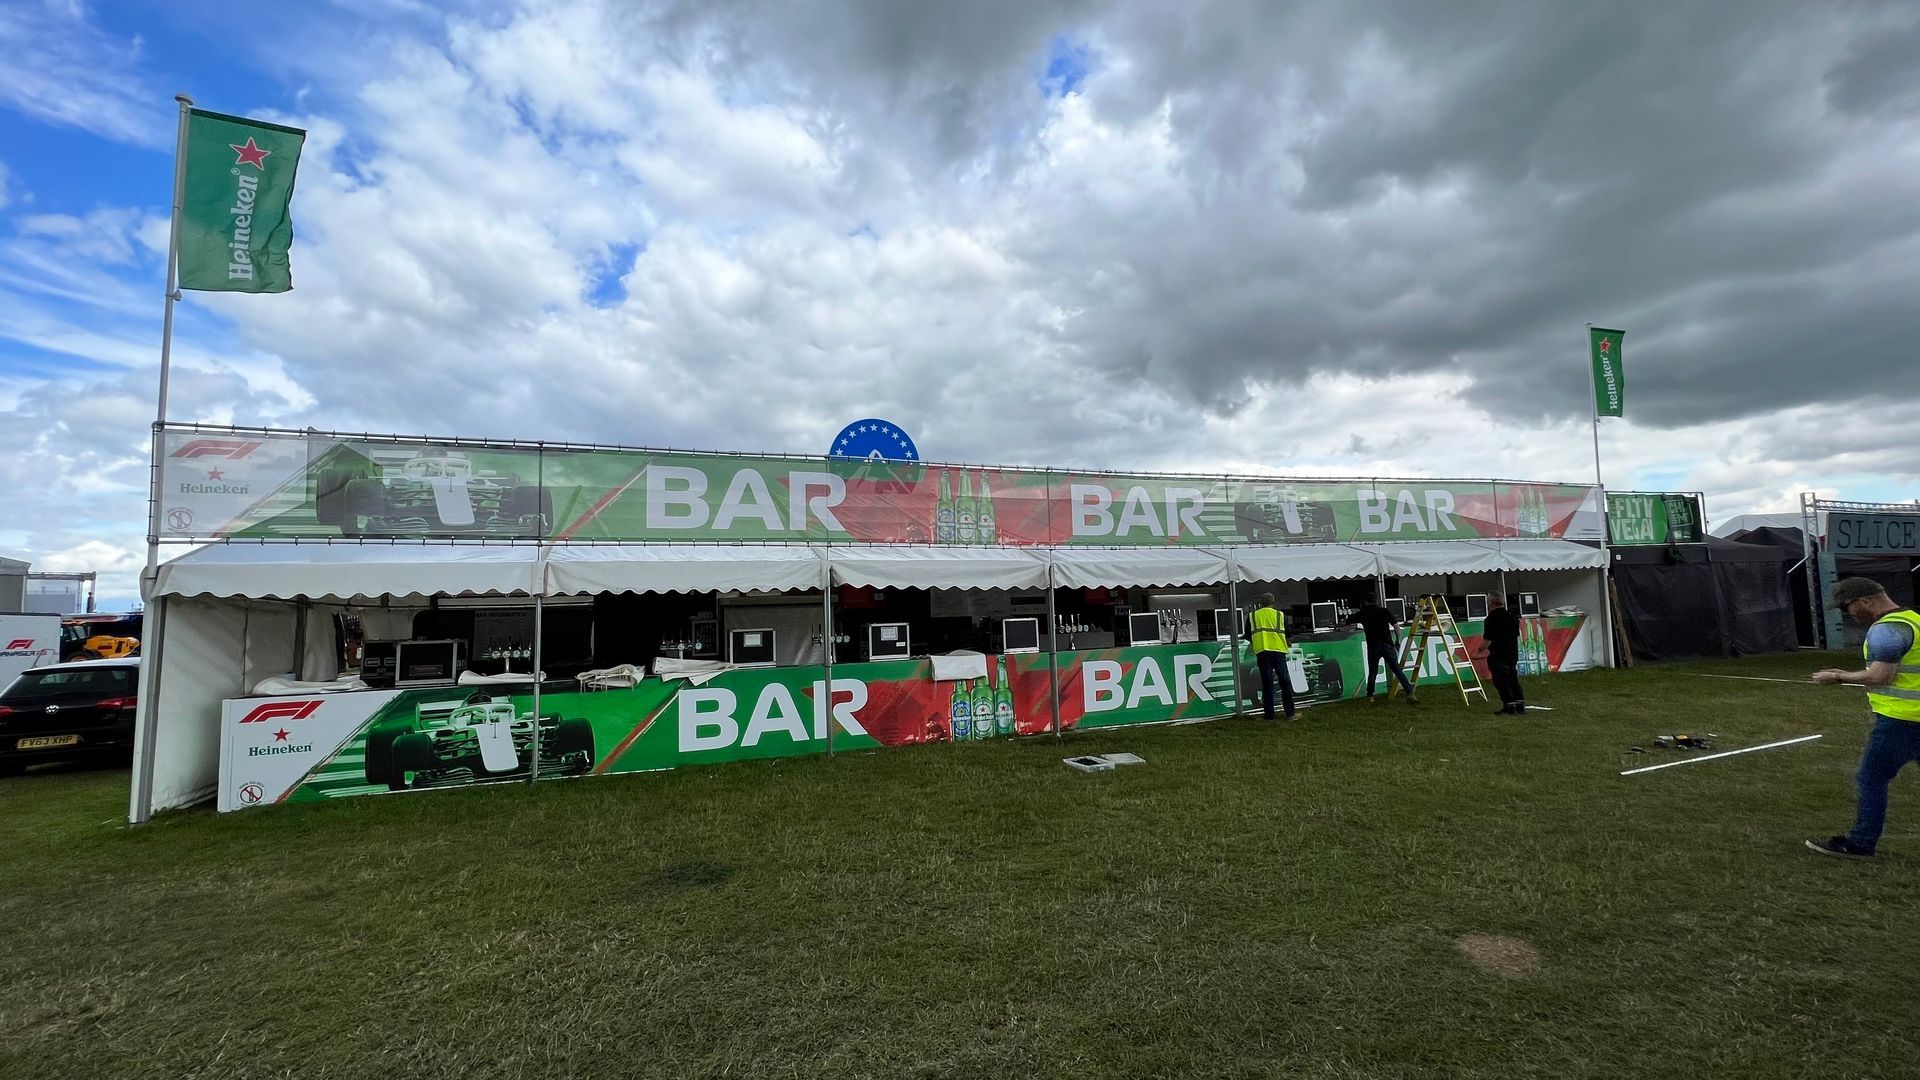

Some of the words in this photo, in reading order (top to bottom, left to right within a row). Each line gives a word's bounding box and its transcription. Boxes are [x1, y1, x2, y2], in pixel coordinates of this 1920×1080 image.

[229, 175, 259, 280] Heineken
[1602, 357, 1618, 409] Heineken
[168, 440, 263, 460] F1
[180, 483, 249, 495] Heineken
[646, 465, 847, 532] BAR
[1071, 484, 1206, 536] BAR
[1358, 489, 1457, 533] BAR
[1838, 519, 1916, 549] SLICE
[1083, 654, 1214, 713] BAR
[239, 700, 326, 723] F1
[679, 678, 869, 752] BAR
[21, 737, 50, 747] FV63
[52, 735, 73, 745] XHP
[249, 744, 312, 756] Heineken
